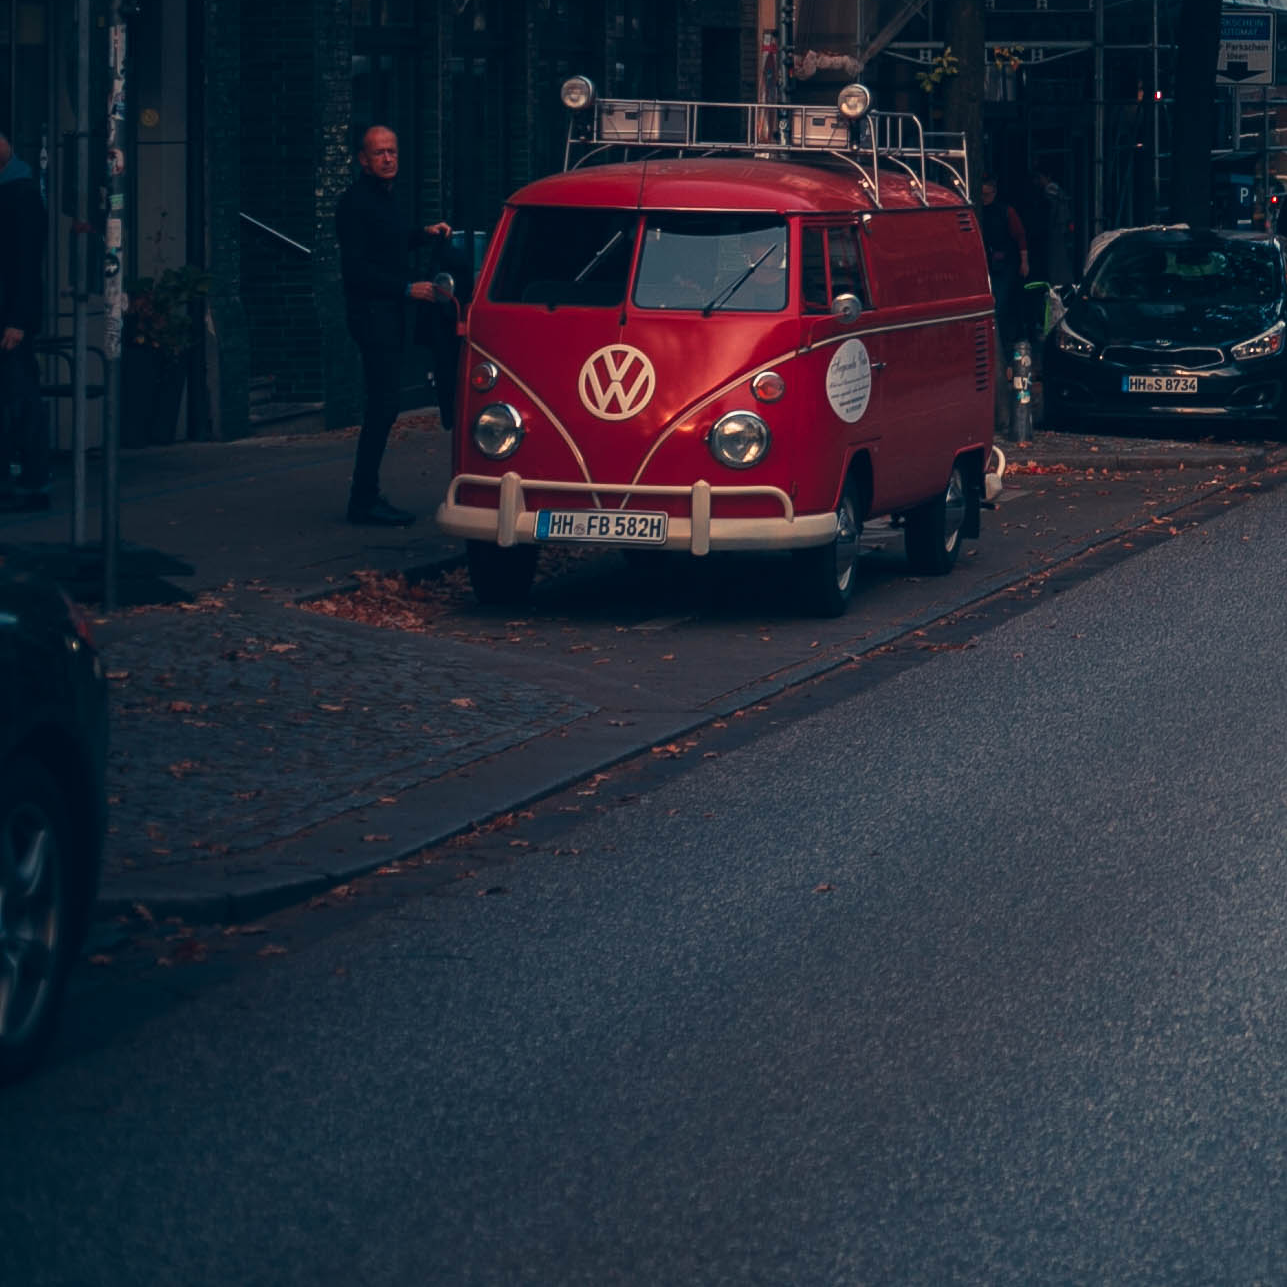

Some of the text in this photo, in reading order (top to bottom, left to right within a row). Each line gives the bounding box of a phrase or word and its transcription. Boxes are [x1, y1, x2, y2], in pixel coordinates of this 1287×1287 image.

[1240, 187, 1249, 203] P
[582, 347, 653, 417] VW
[1129, 378, 1146, 391] HH
[1165, 378, 1196, 391] 8734
[550, 514, 662, 538] HH FB 582H
